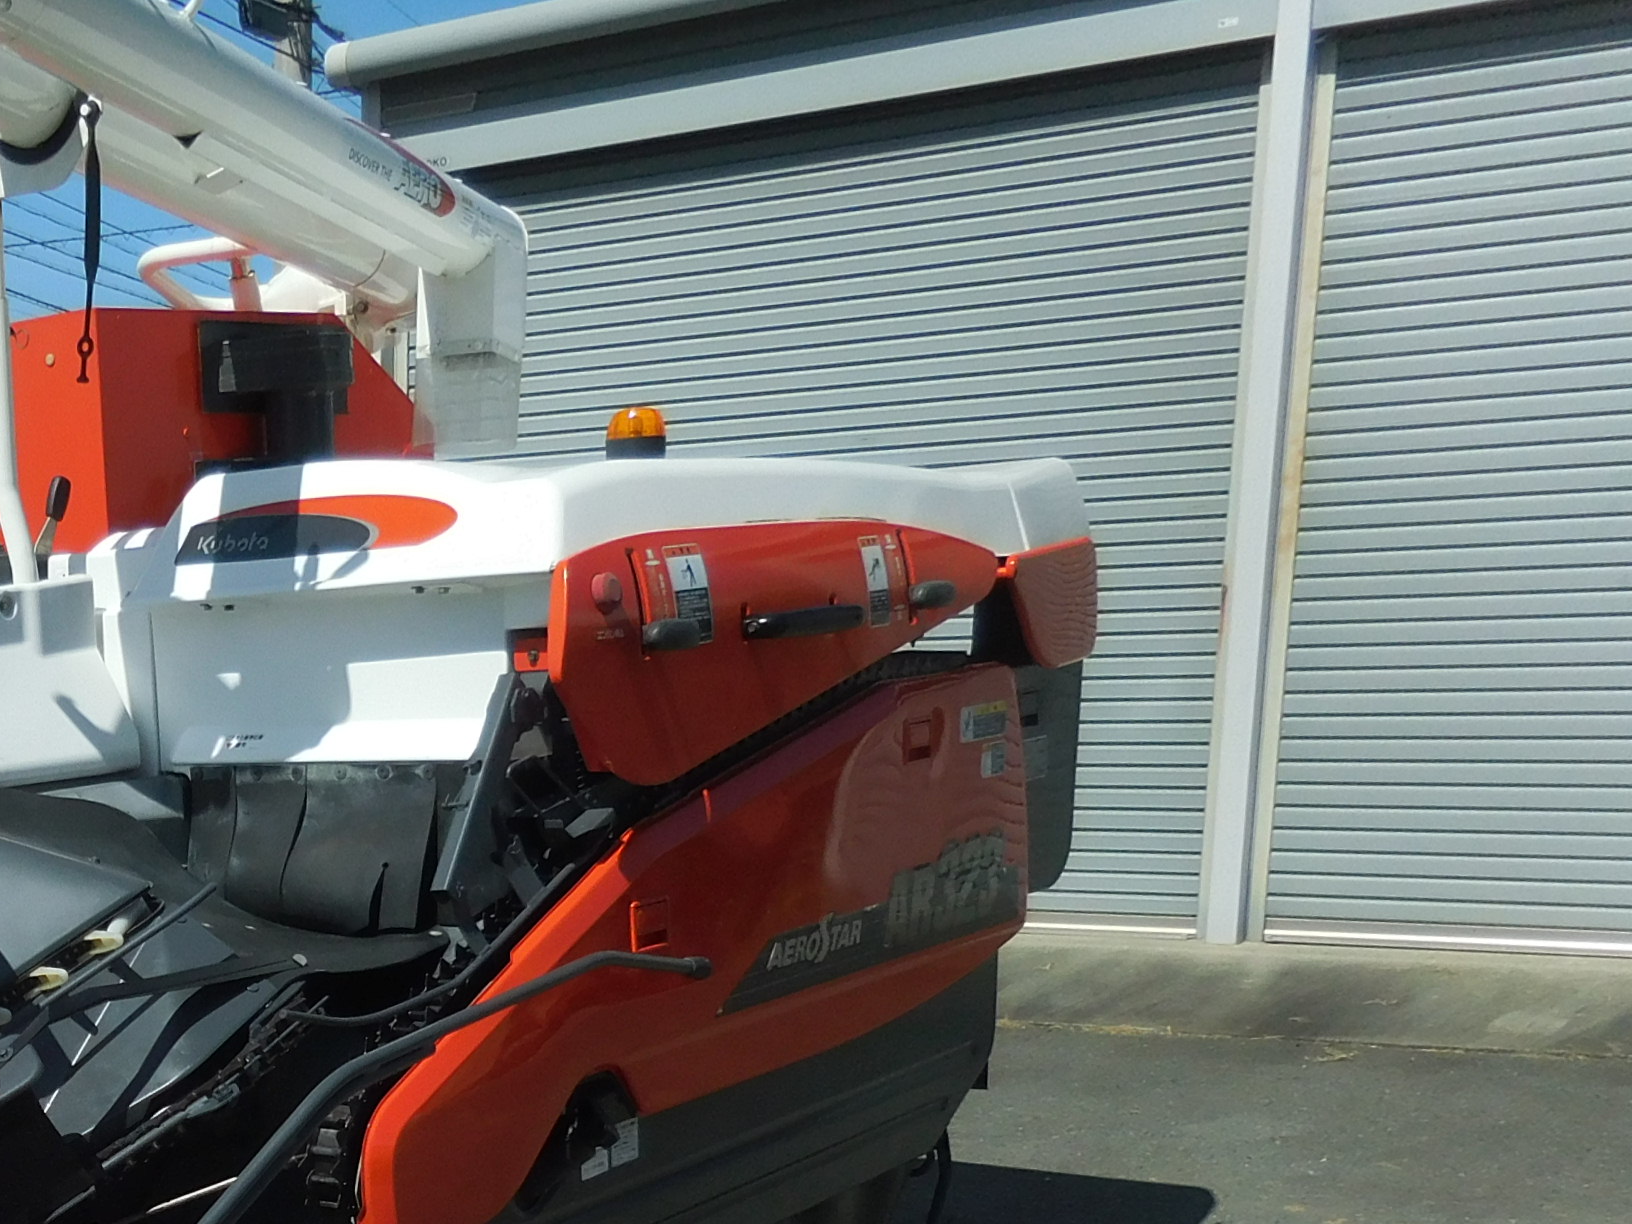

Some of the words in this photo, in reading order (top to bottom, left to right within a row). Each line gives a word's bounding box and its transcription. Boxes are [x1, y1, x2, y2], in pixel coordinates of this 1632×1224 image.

[348, 148, 380, 176] DISCOVER
[380, 164, 393, 182] THE
[197, 531, 269, 555] Kubota
[767, 911, 862, 971] AEROSTAR
